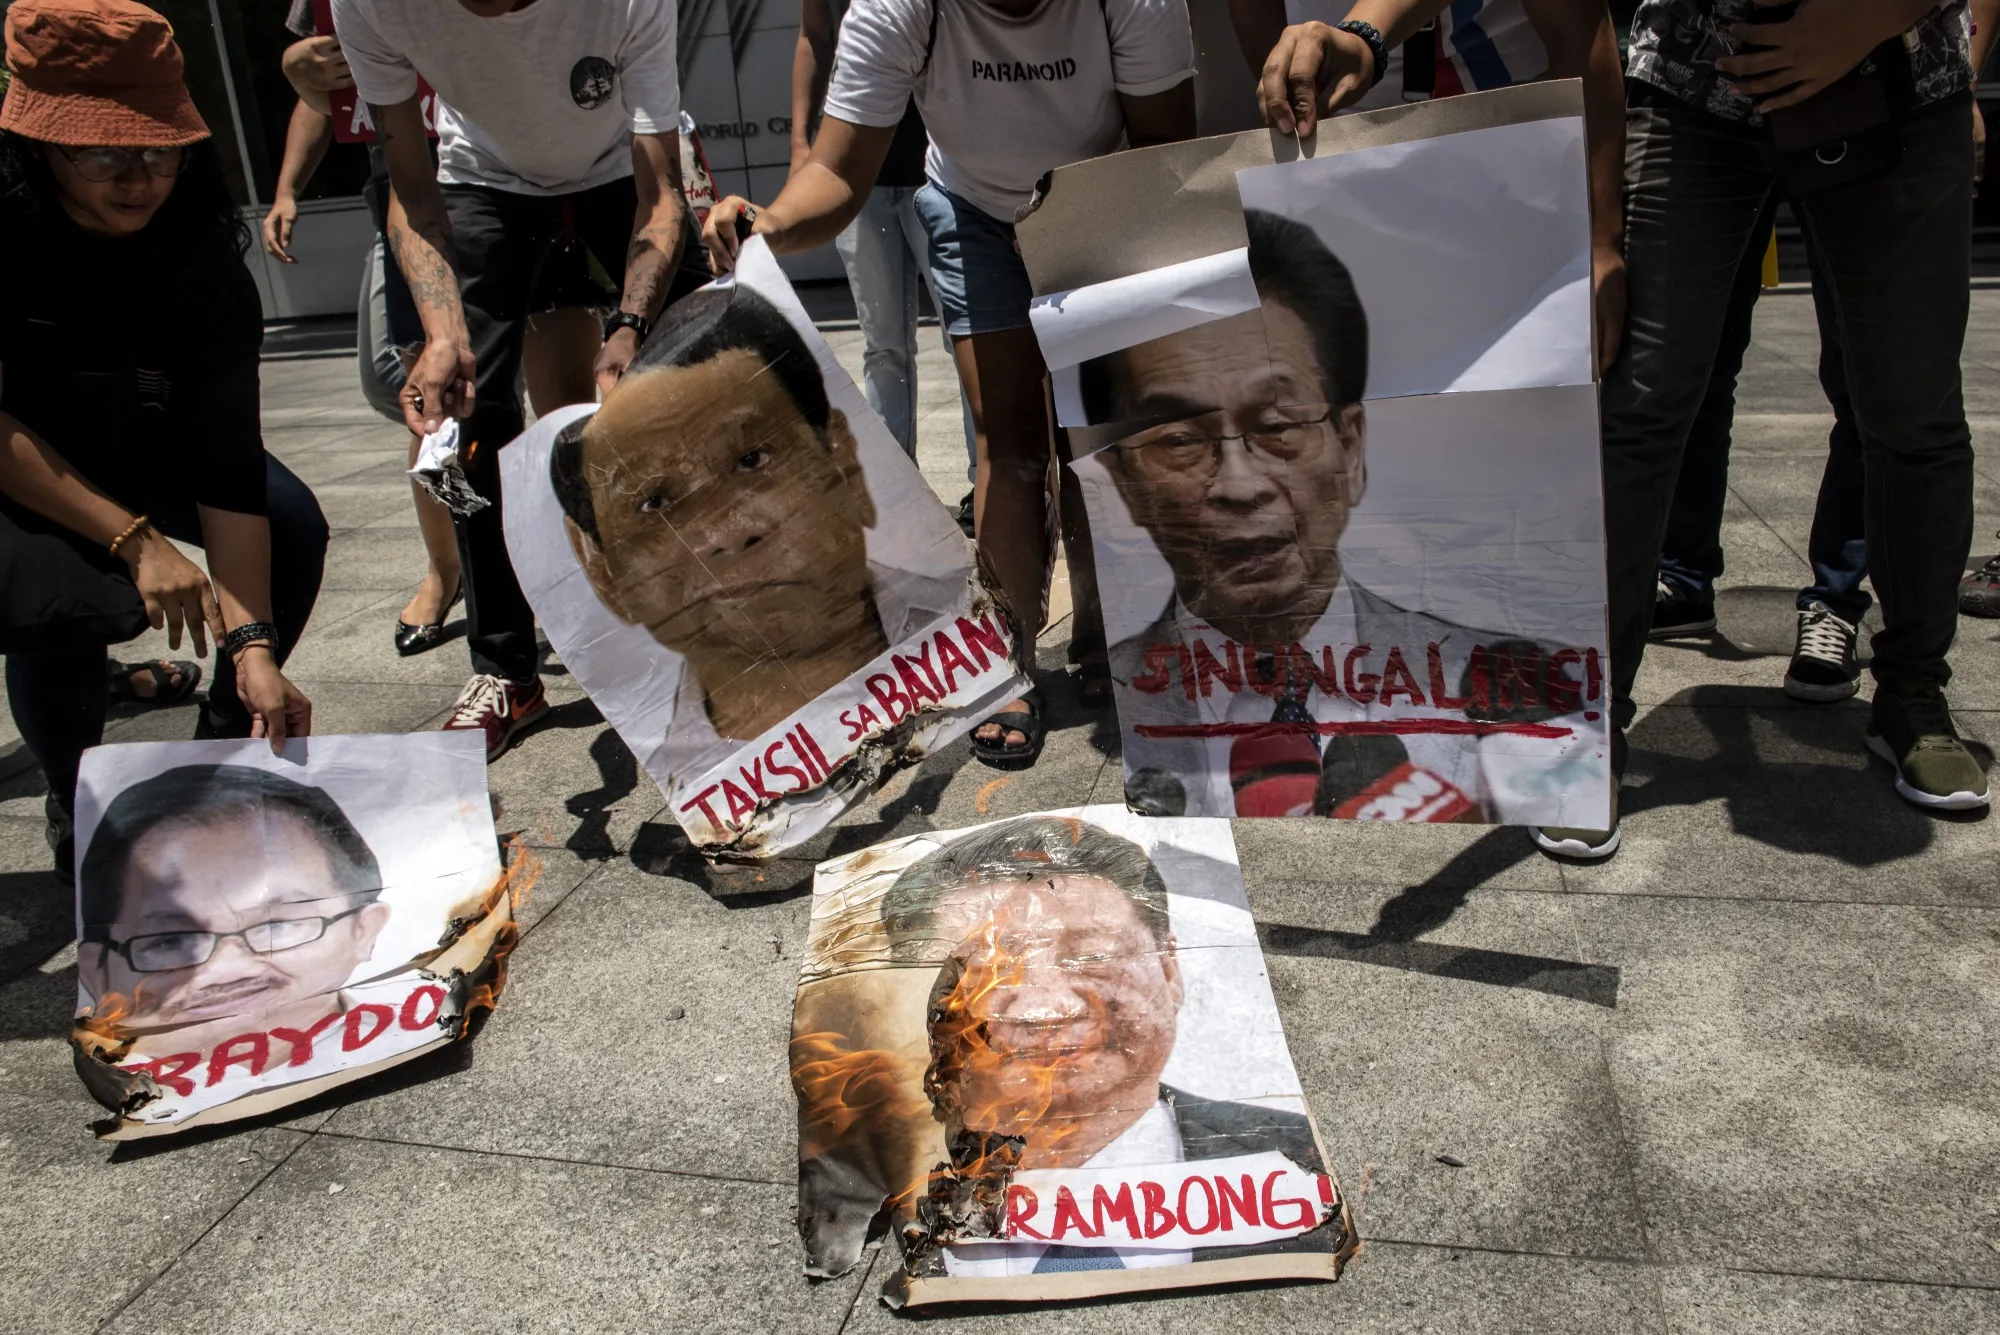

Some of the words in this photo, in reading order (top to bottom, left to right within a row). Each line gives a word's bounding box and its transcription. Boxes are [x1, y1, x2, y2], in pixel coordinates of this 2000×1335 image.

[972, 58, 1076, 82] PARANOID
[1666, 60, 1695, 79] MUSIC
[1132, 638, 1604, 722] SINUNGALING!
[680, 722, 850, 838] TAKSIL
[840, 704, 880, 741] SA
